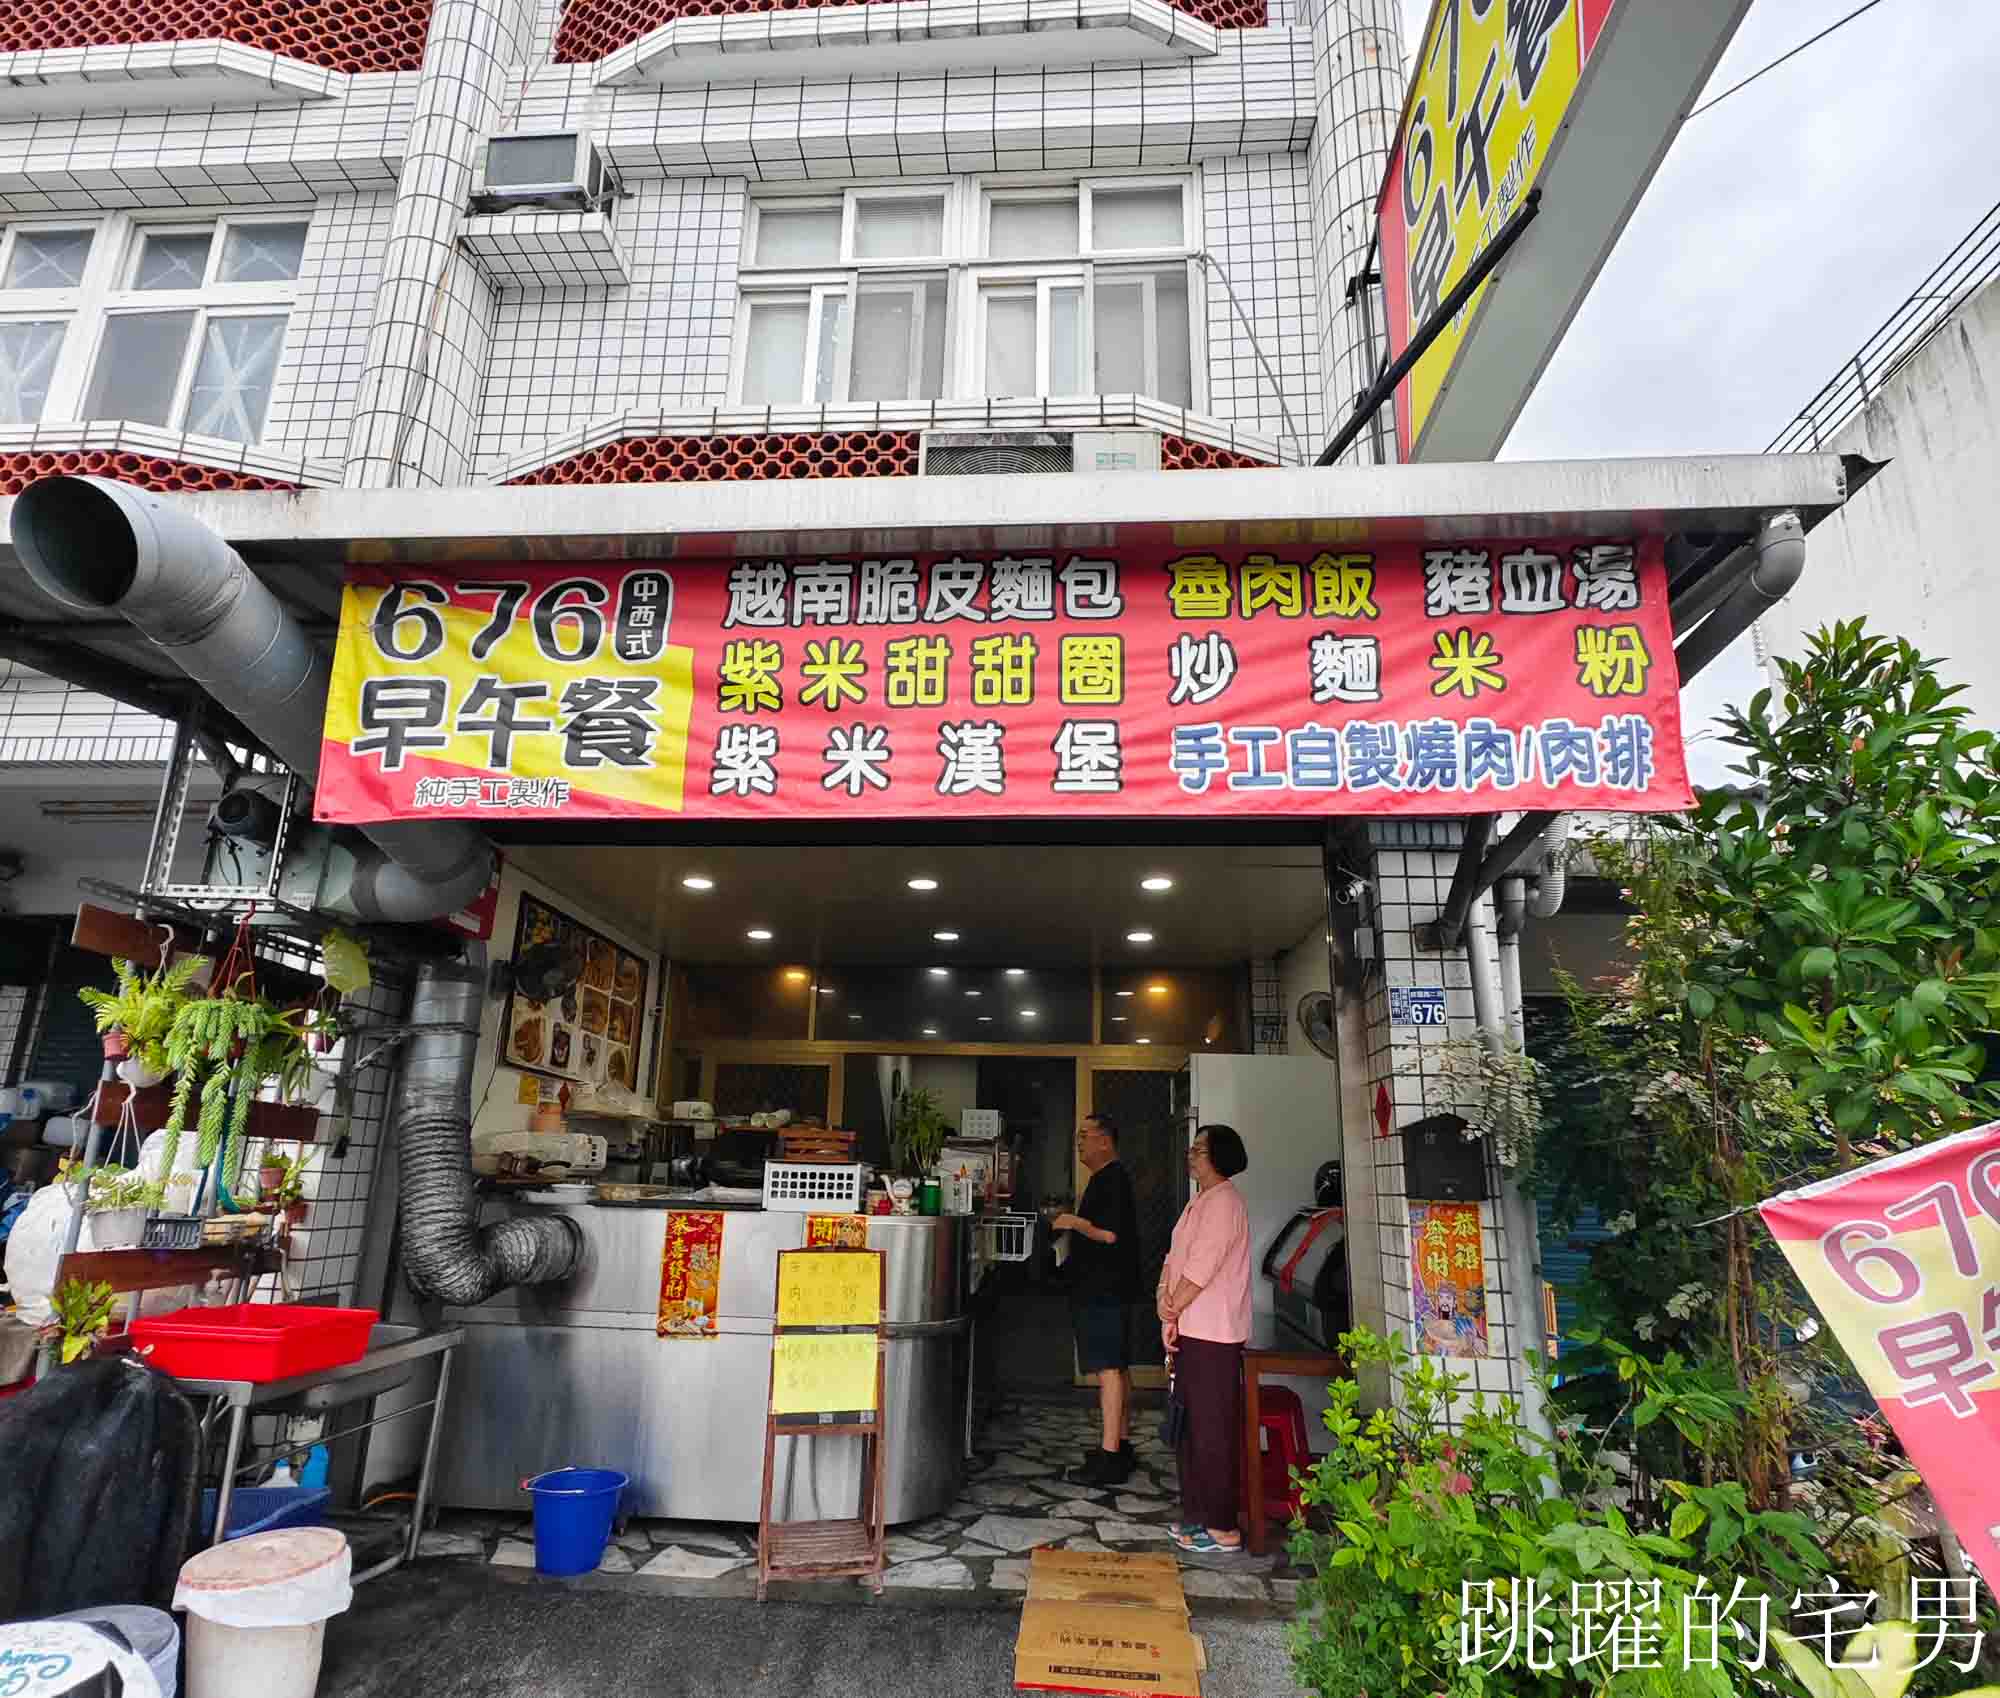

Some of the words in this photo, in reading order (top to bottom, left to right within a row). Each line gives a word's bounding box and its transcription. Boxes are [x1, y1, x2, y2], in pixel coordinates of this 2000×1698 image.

[1404, 0, 1494, 226] 67
[625, 575, 659, 658] 中西式
[724, 556, 1121, 628] 越南脆皮麵包
[1168, 552, 1378, 620] 魯肉飯
[1424, 545, 1640, 617] 豬血湯
[371, 578, 610, 662] 676
[718, 633, 1123, 712] 紫米甜甜圈
[350, 676, 662, 770] 早午餐
[711, 720, 1122, 797] 紫米漢堡
[1168, 716, 1654, 793] 手工自製燒肉/肉排
[415, 776, 569, 808] 純手工製作
[1411, 1003, 1446, 1024] 676
[1876, 1311, 2000, 1419] 早
